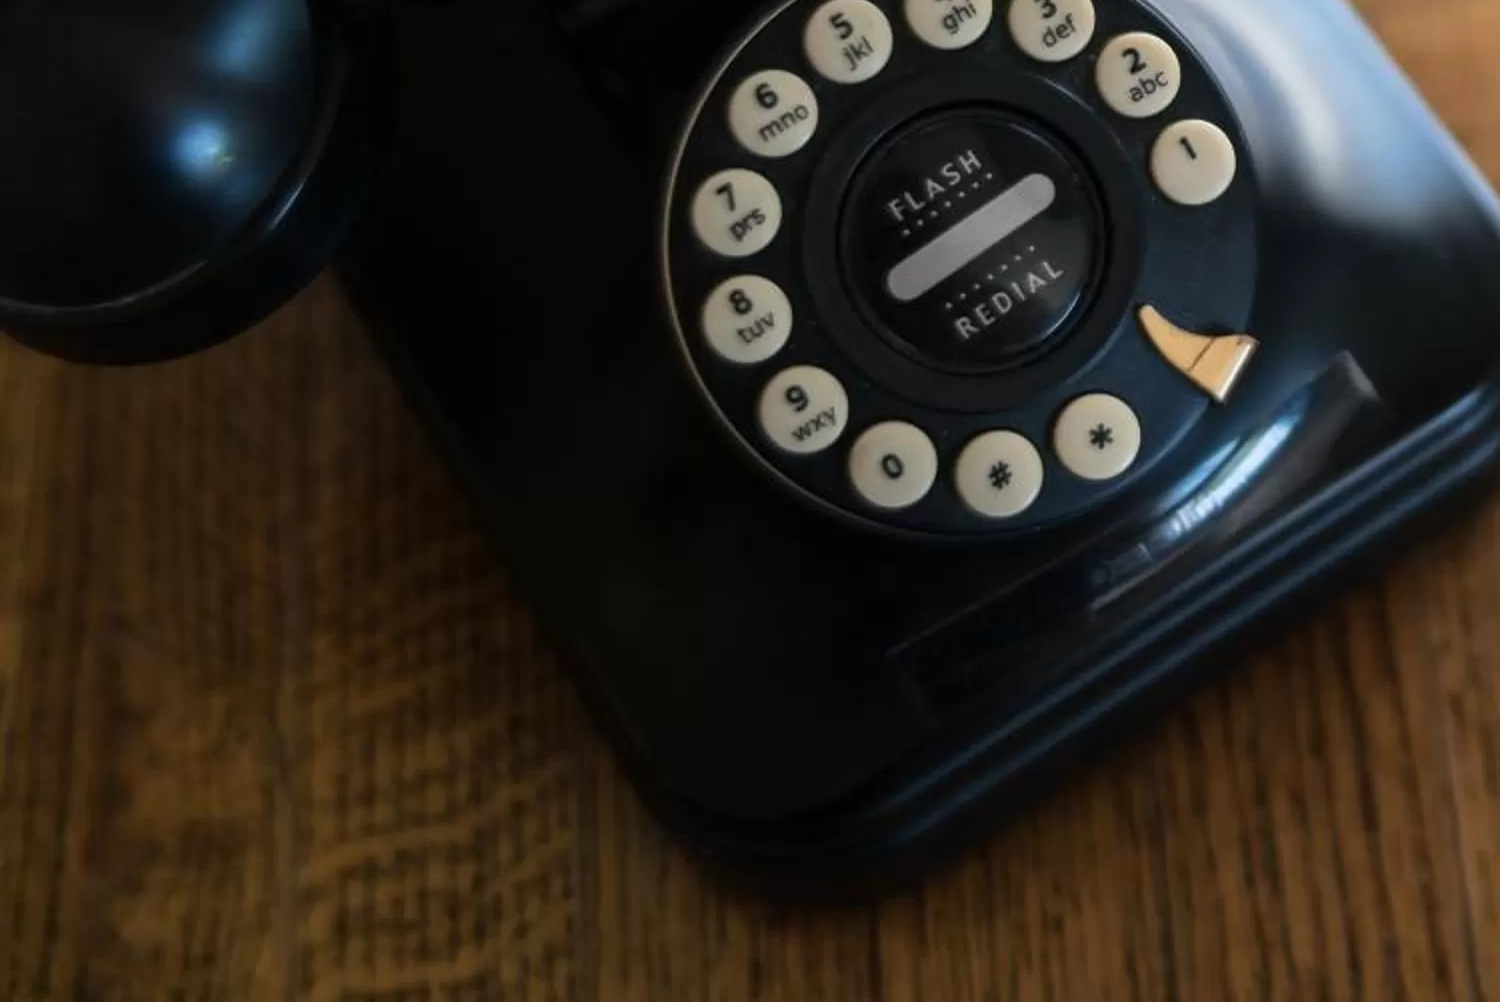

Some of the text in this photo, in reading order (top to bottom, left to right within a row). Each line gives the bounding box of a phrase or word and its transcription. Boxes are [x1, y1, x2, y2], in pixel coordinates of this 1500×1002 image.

[829, 11, 855, 41] 5
[941, 0, 978, 35] ghi
[1041, 13, 1077, 48] def
[841, 38, 875, 72] jkl
[1121, 47, 1148, 75] 2
[754, 82, 779, 110] 6
[1128, 71, 1170, 103] abc
[757, 105, 810, 143] mno
[1179, 136, 1198, 160] 1
[715, 181, 738, 212] 7
[888, 149, 983, 221] FLASH
[728, 208, 767, 243] prs
[728, 288, 754, 317] 8
[954, 260, 1065, 340] REDIAL
[736, 311, 776, 345] tuv
[784, 384, 810, 413] 9
[790, 405, 838, 443] wxy
[880, 453, 904, 481] 0
